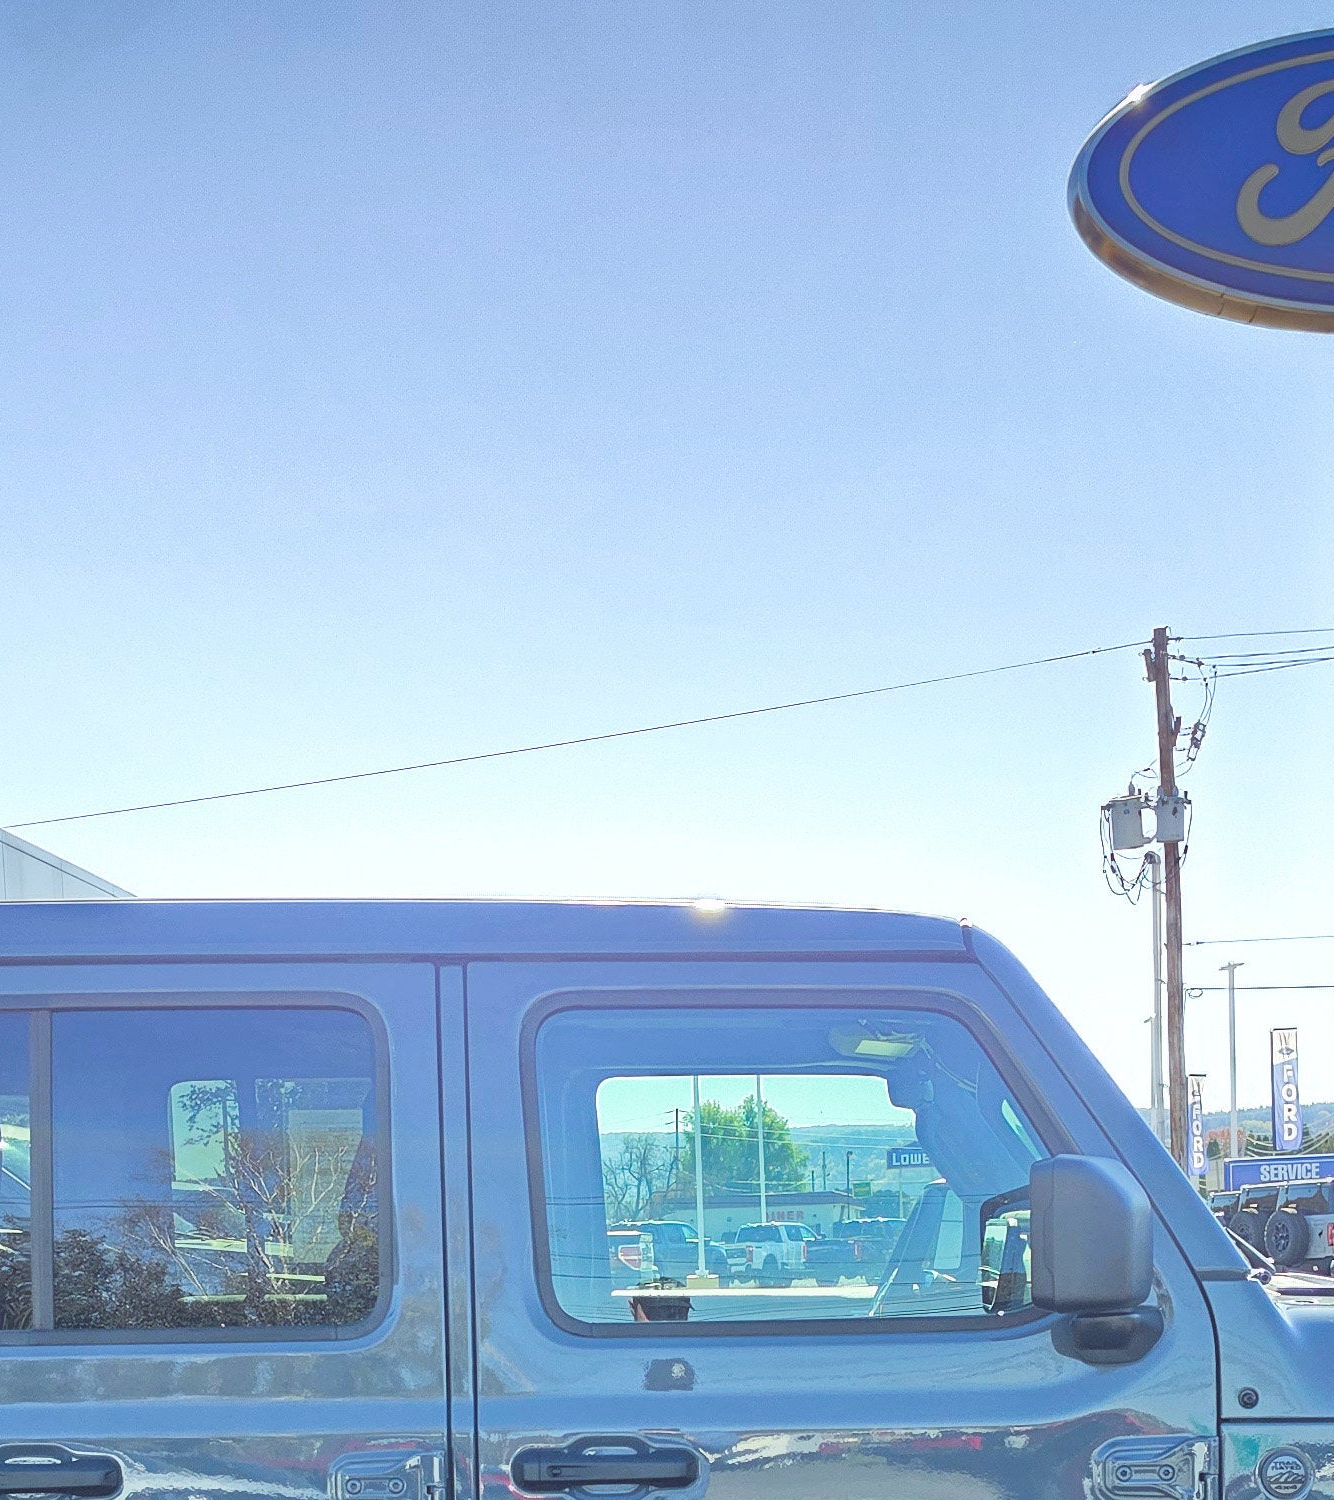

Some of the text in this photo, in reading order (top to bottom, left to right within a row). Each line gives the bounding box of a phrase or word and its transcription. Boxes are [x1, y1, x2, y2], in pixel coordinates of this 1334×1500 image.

[1281, 1064, 1298, 1141] FORD
[1192, 1107, 1205, 1169] FORD
[1259, 1163, 1320, 1181] SERVICE
